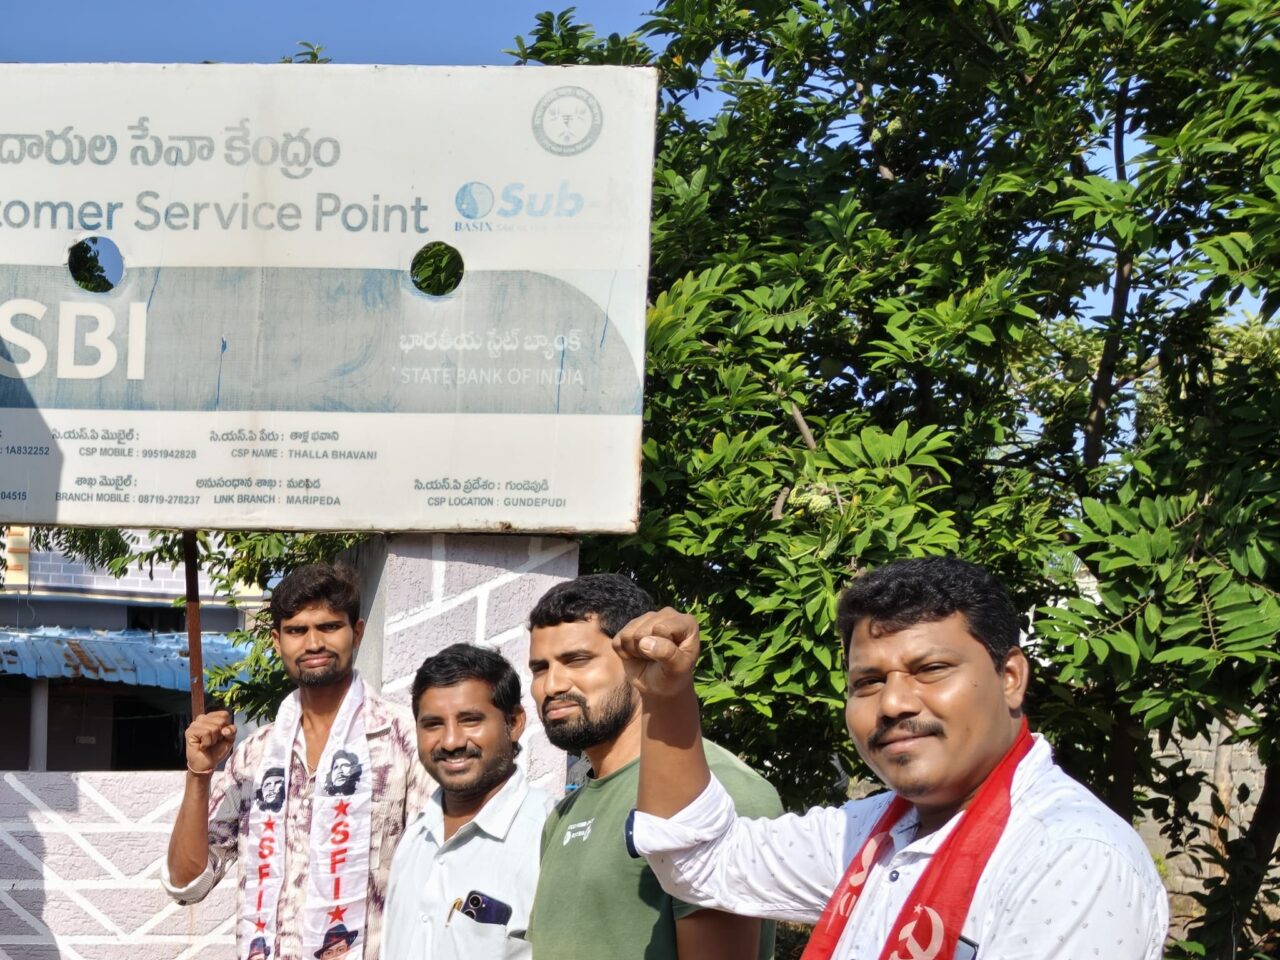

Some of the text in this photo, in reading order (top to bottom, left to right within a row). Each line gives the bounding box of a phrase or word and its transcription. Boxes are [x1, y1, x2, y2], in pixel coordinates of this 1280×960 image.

[127, 116, 215, 166] సేవా
[224, 117, 340, 179] కేంద్రం
[133, 190, 302, 231] Service
[316, 192, 430, 234] Point
[400, 367, 583, 385] STATE BANK OF INDIA
[6, 446, 50, 456] 1A832252
[79, 447, 97, 456] CSP
[99, 448, 133, 457] MOBILE
[142, 449, 197, 459] 9951942828
[231, 449, 249, 458] CSP
[252, 449, 278, 458] NAME
[288, 450, 329, 459] THALLA
[331, 450, 377, 460] BHAVANI
[0, 490, 27, 500] 04515
[56, 491, 93, 502] BRANCH
[96, 492, 130, 502] MOBILE
[214, 494, 234, 504] LINK
[237, 494, 275, 504] BRANCH
[286, 496, 341, 506] MARIPEDA
[427, 497, 446, 506] CSP
[448, 497, 494, 507] LOCATION
[503, 497, 567, 508] GUNDEPUDI
[330, 820, 350, 901] SFI
[256, 837, 276, 912] SFI
